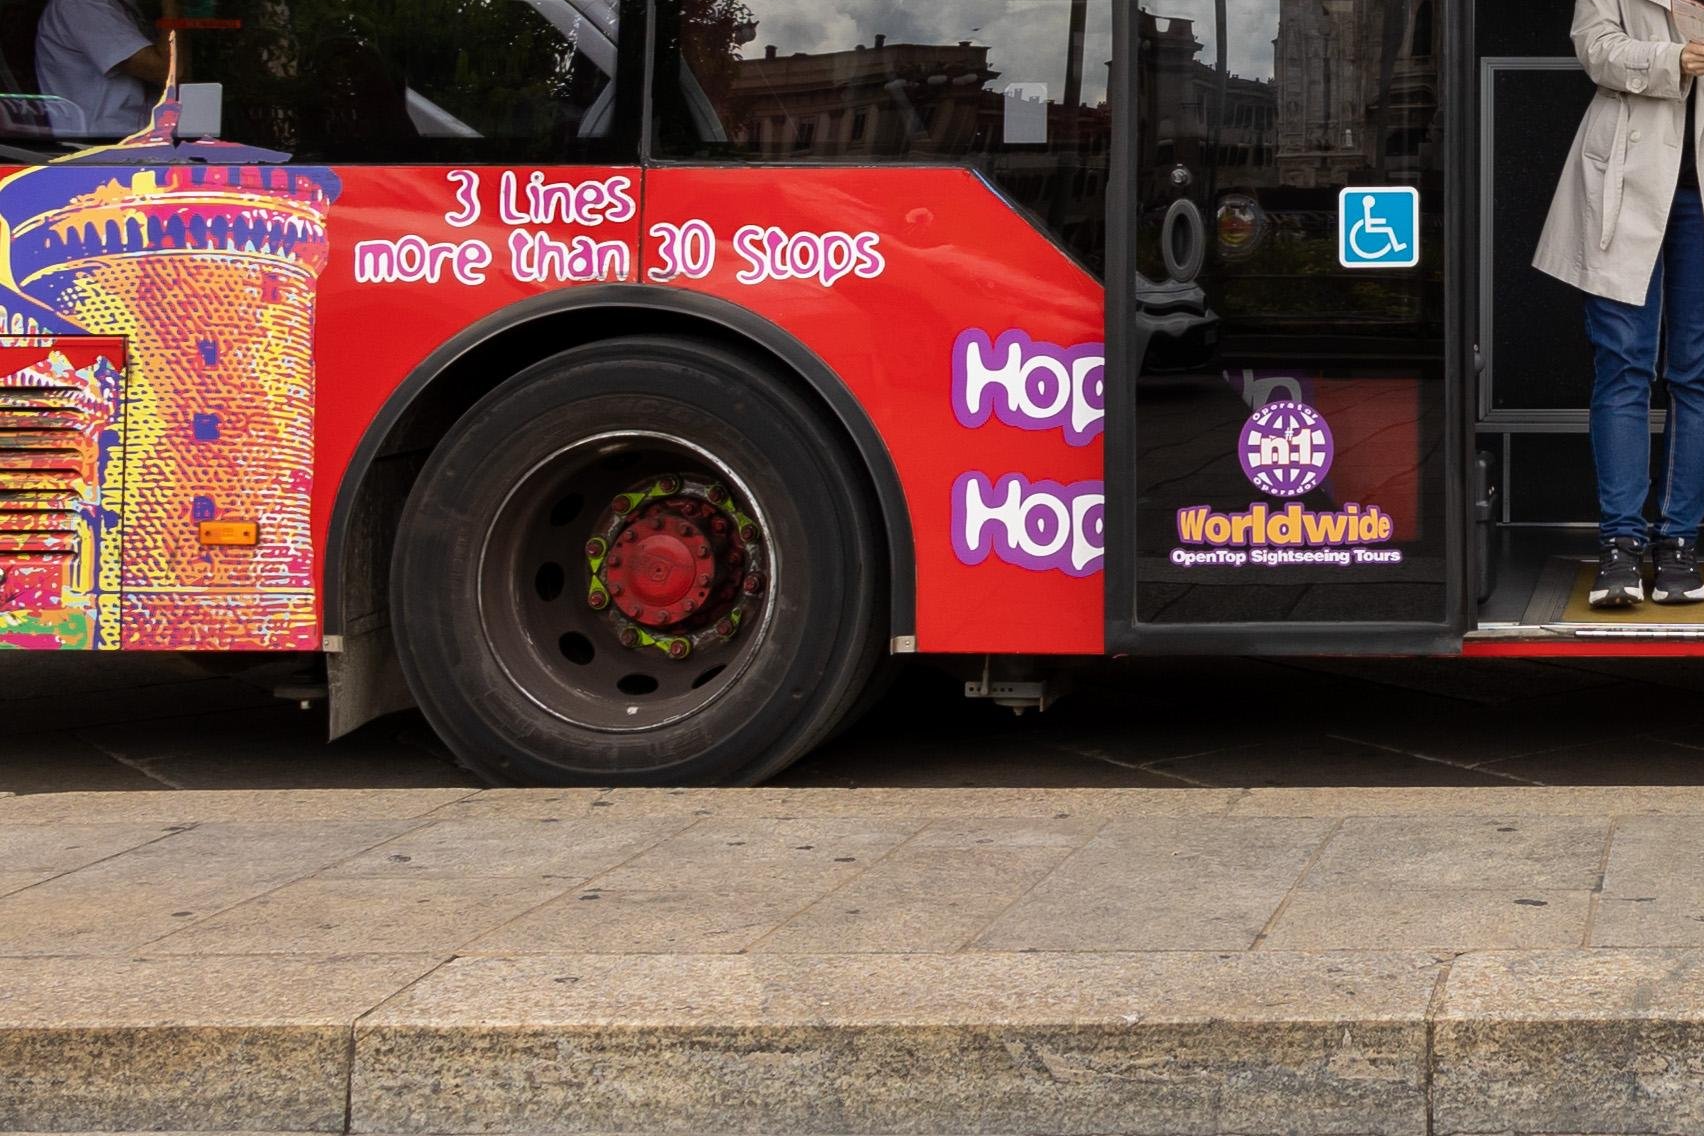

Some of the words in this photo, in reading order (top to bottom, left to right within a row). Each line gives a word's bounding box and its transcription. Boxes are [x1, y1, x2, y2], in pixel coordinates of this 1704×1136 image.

[444, 170, 481, 227] 3
[499, 171, 636, 226] Lines
[355, 234, 492, 285] more
[511, 227, 631, 283] than
[647, 220, 716, 282] 30
[734, 224, 886, 286] Stops
[1178, 504, 1392, 545] Worldwide
[1251, 548, 1351, 564] Sightseeing
[1353, 548, 1402, 563] Tours
